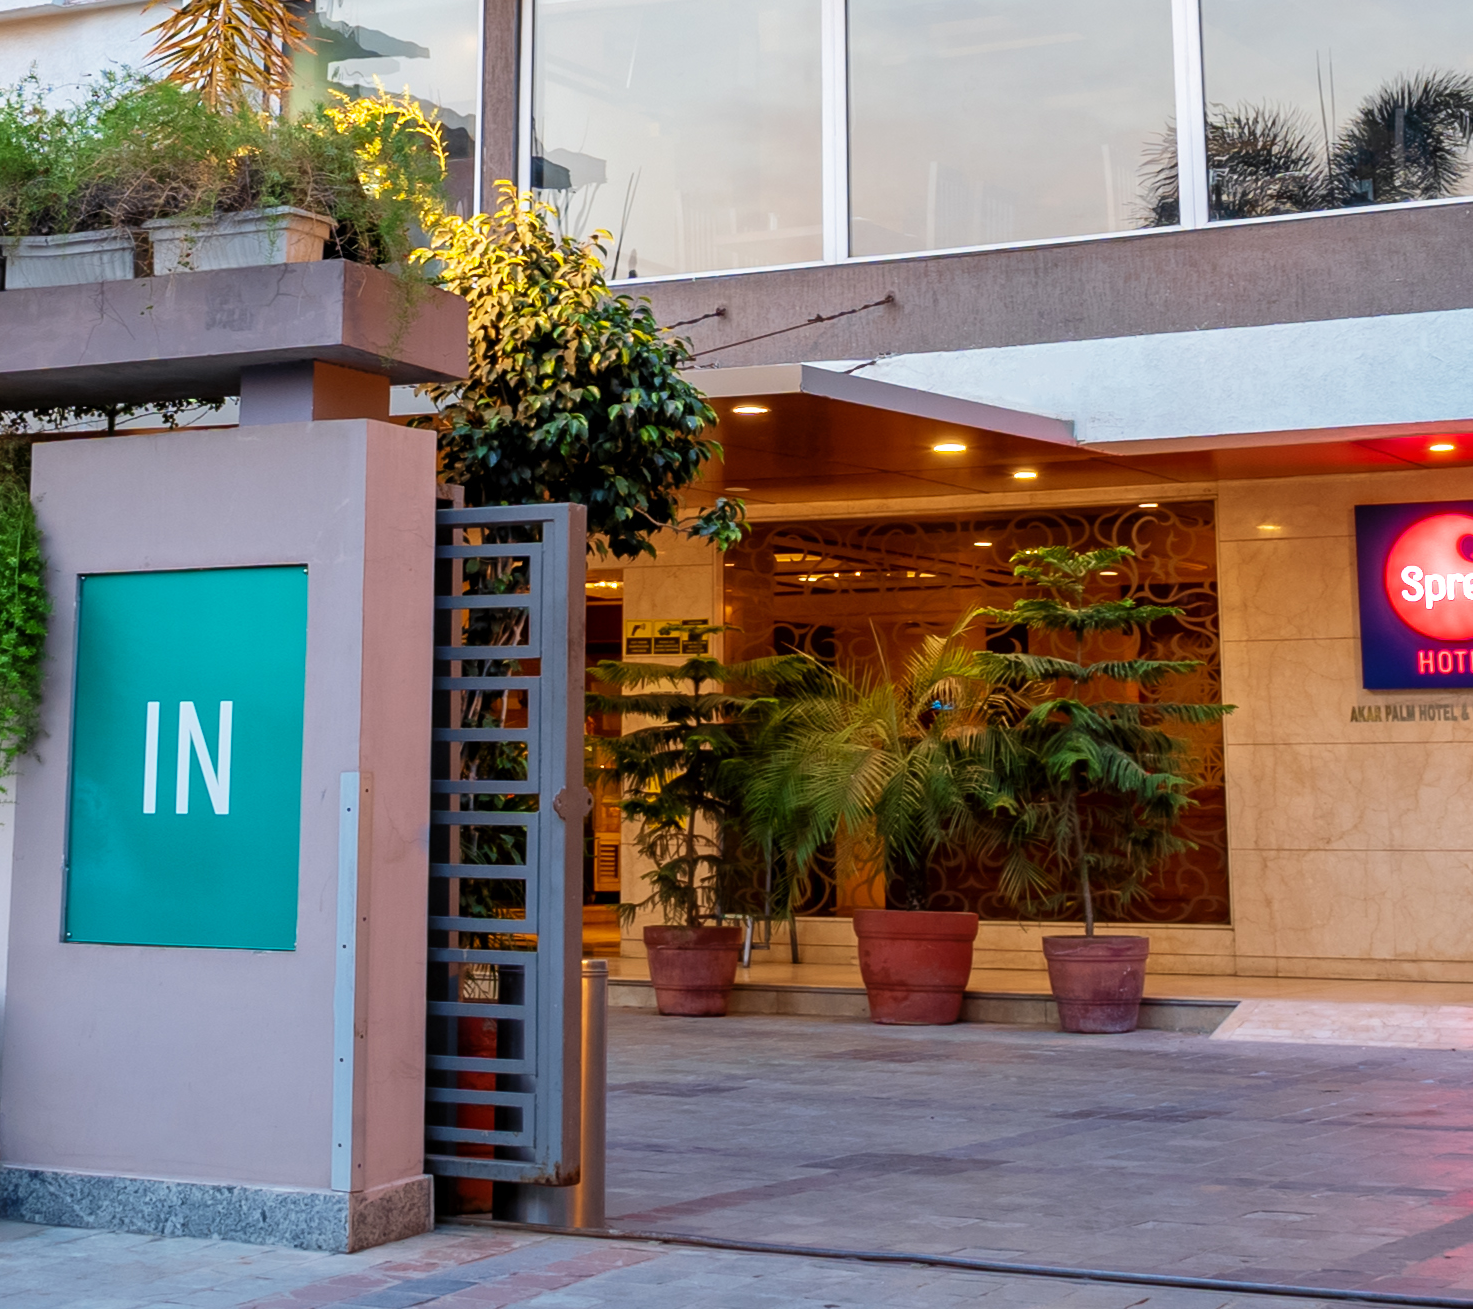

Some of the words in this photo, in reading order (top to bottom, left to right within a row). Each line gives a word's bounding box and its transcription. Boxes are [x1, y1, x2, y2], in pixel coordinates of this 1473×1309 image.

[1350, 705, 1383, 723] AKAR
[1385, 704, 1416, 722] PALM
[1419, 704, 1458, 722] HOTEL
[1461, 703, 1470, 721] &
[142, 700, 234, 815] IN
